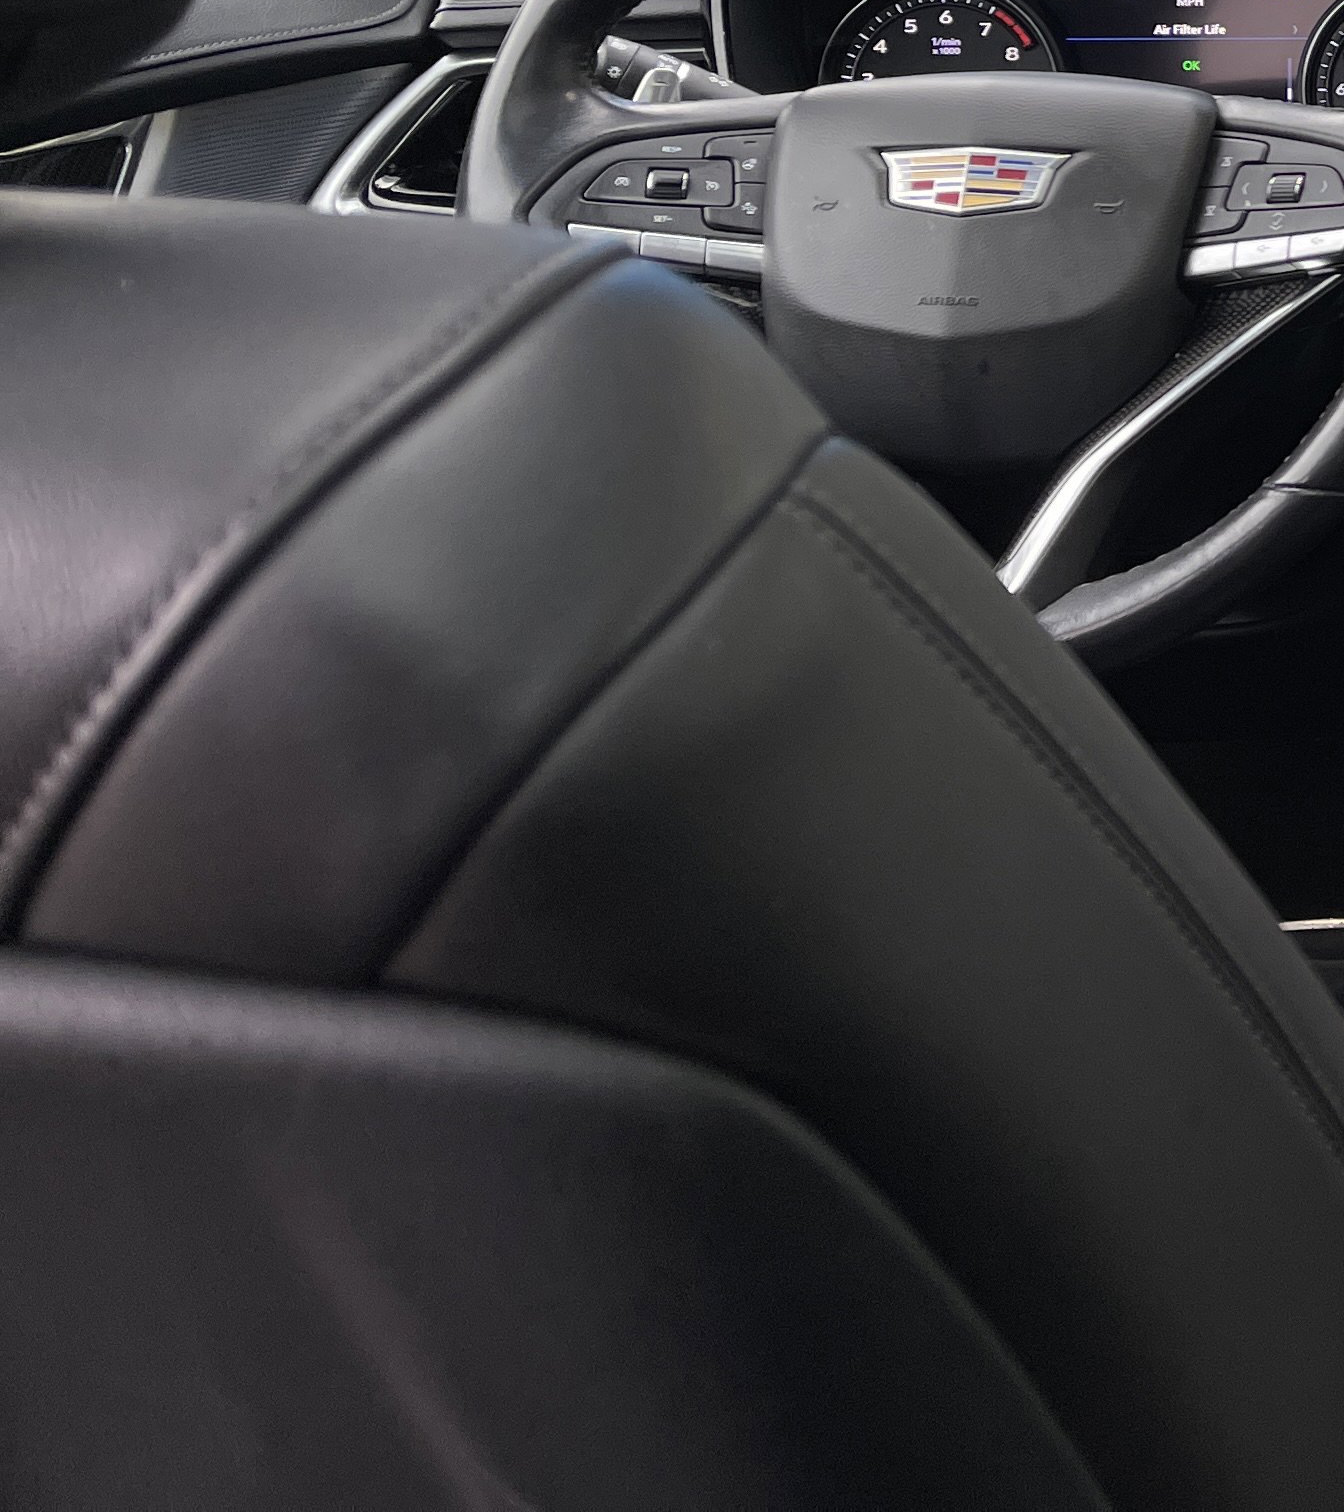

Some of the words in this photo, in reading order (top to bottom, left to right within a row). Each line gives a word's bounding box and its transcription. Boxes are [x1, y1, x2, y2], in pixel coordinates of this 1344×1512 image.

[939, 10, 954, 25] 6
[904, 18, 918, 34] 5
[979, 22, 993, 37] 7
[1153, 24, 1172, 35] Air
[1172, 24, 1204, 35] Filter
[1204, 24, 1227, 35] Life
[873, 39, 888, 54] 4
[931, 37, 962, 47] 1/min
[1005, 46, 1020, 62] 8
[1182, 60, 1201, 71] OK
[917, 295, 980, 307] AIRBAG
